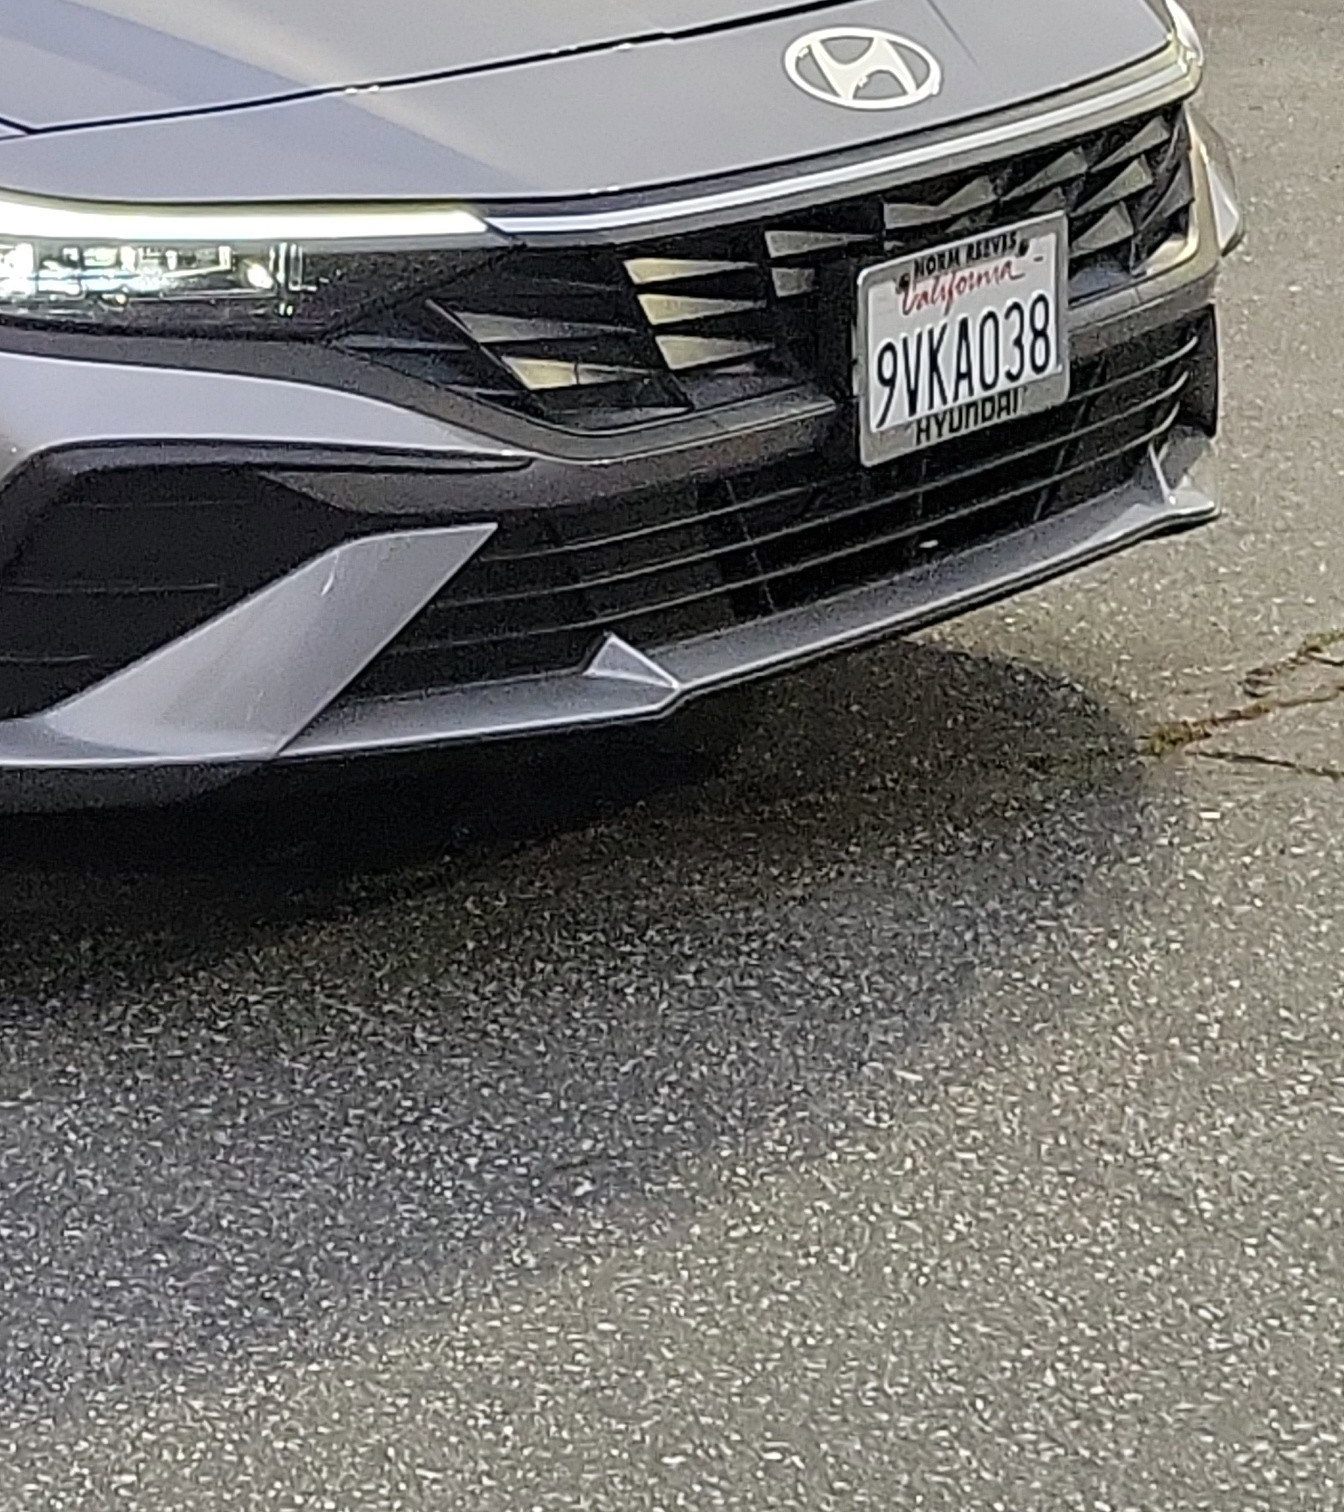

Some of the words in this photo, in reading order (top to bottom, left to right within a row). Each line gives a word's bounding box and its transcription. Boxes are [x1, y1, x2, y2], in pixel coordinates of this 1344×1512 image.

[914, 247, 960, 279] NORM
[967, 231, 1018, 262] REEVES
[900, 259, 1026, 316] California
[875, 292, 1052, 429] 9VKA038
[915, 389, 1023, 446] HYUNDAI
